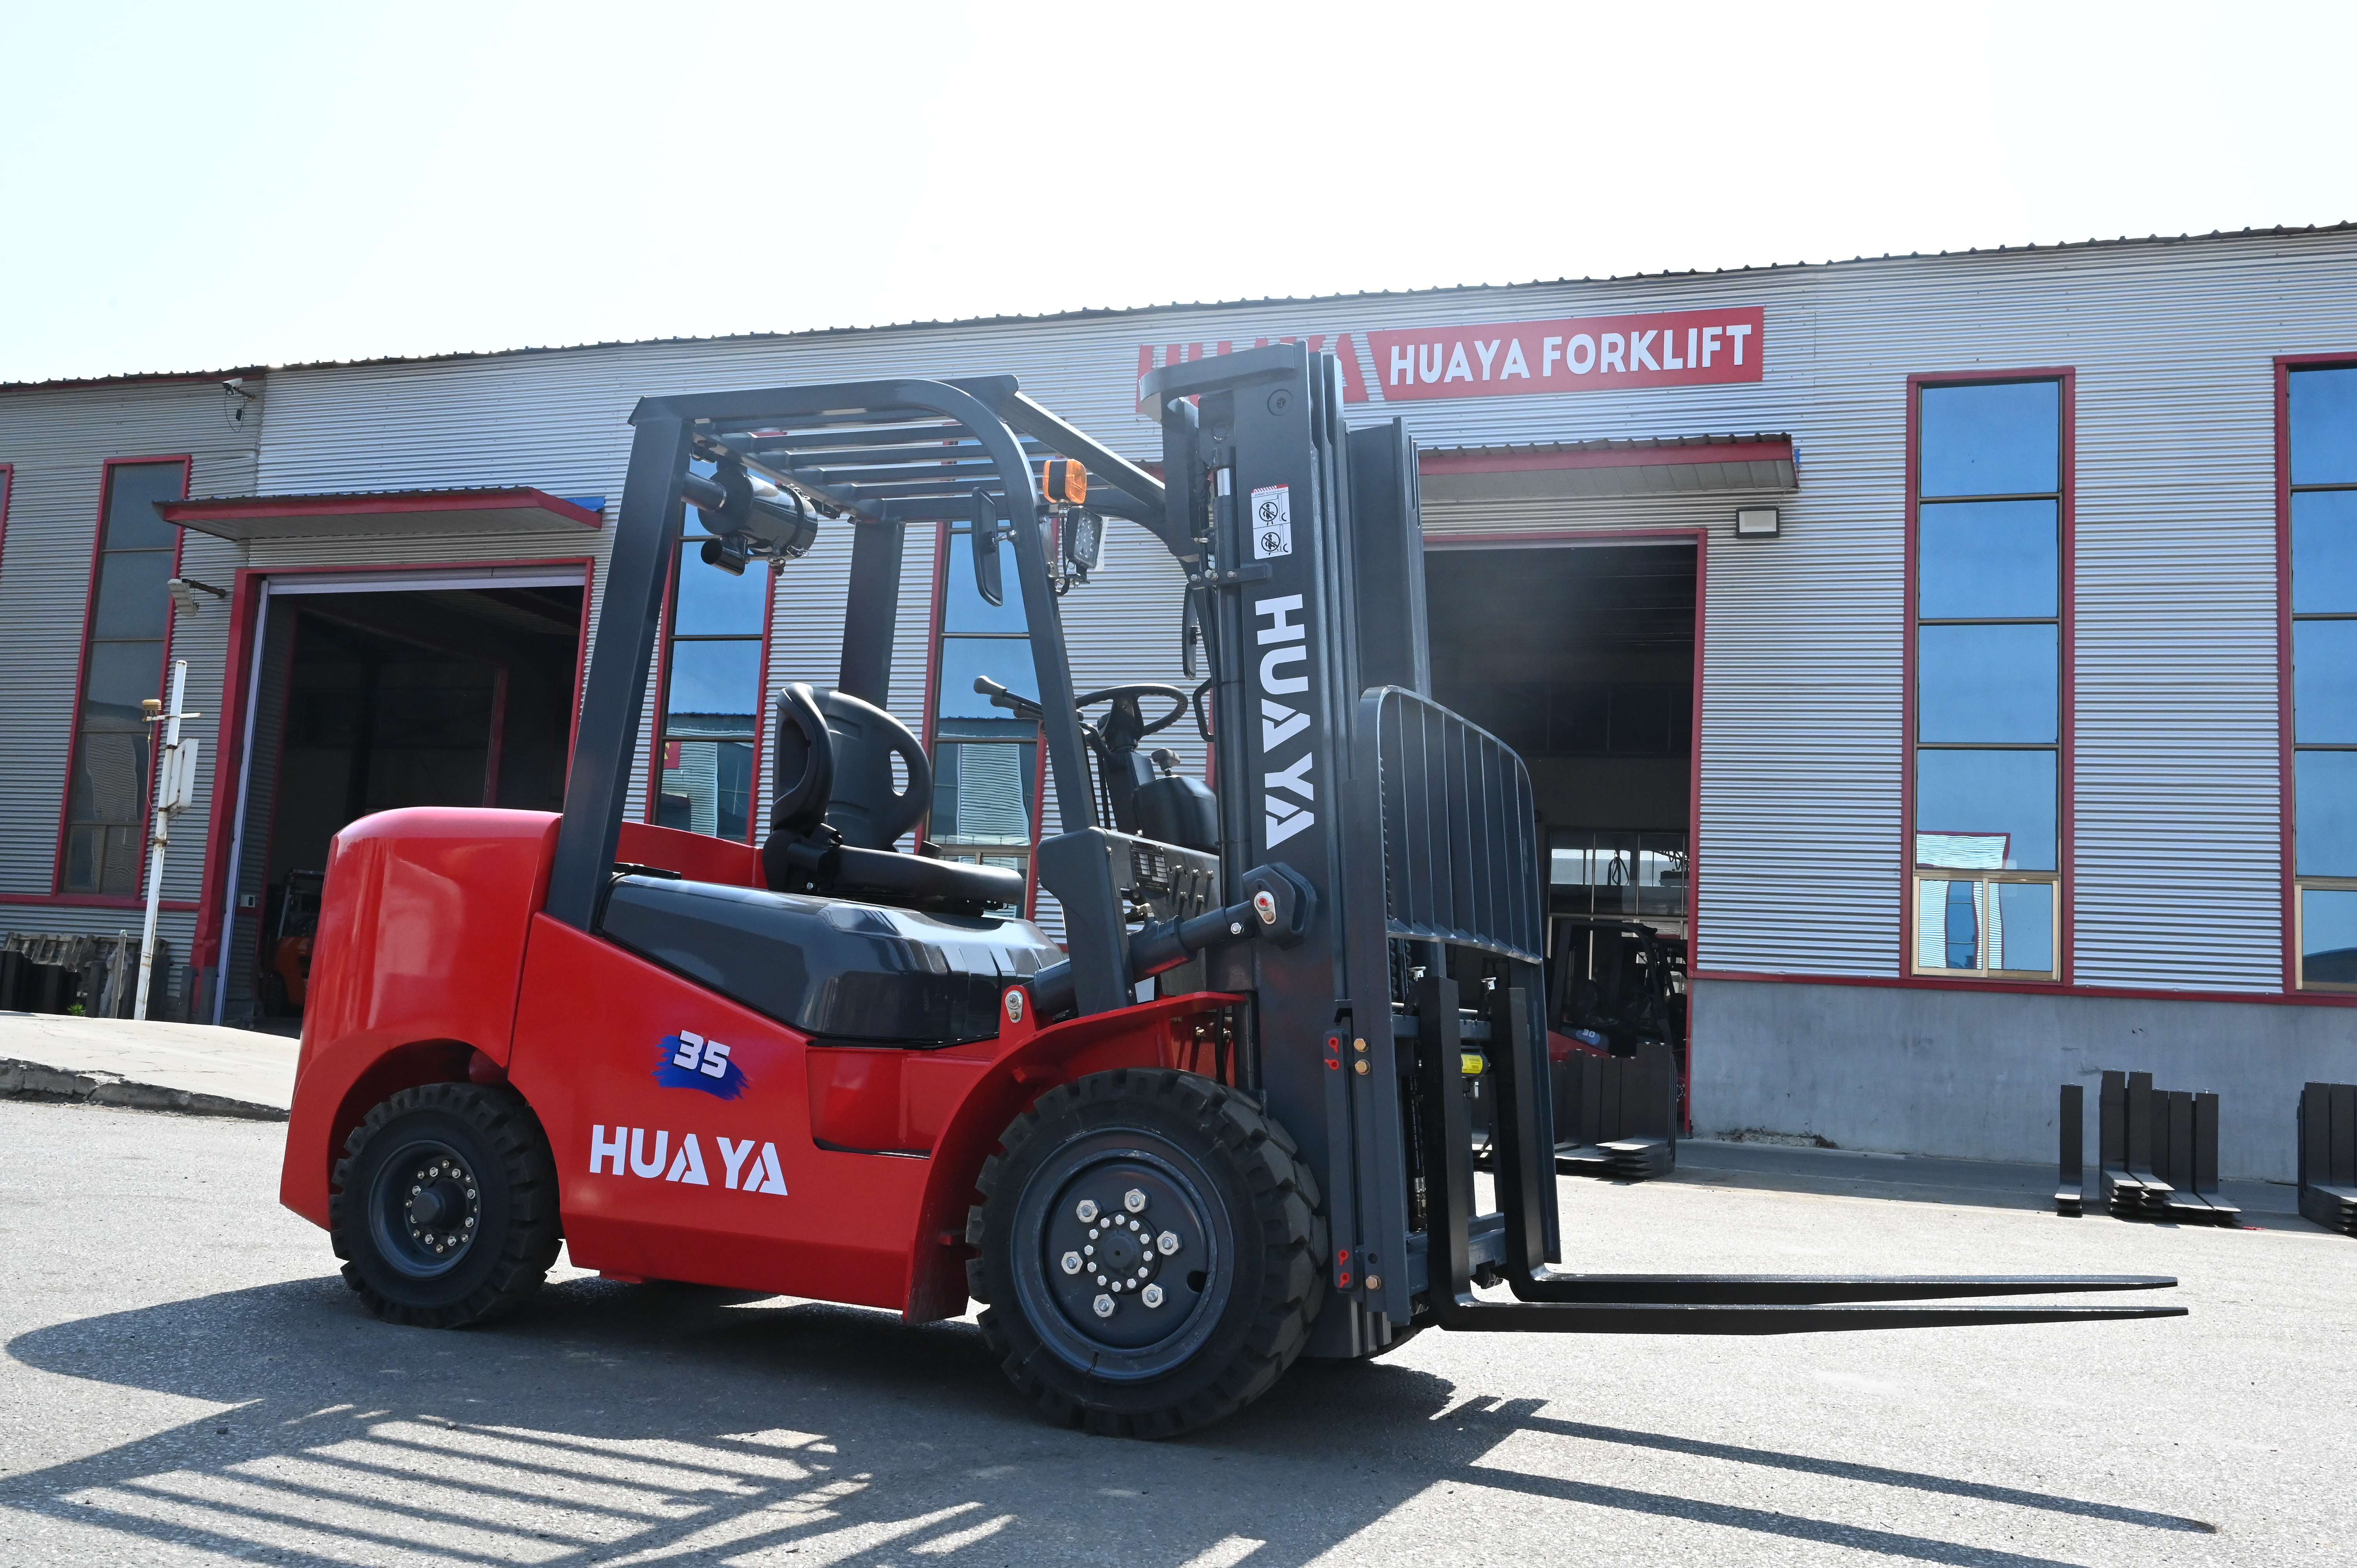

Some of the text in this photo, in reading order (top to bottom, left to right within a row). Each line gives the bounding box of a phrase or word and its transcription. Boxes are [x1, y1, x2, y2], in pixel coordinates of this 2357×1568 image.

[1390, 338, 1531, 385] HUAYA
[1542, 324, 1751, 377] FORKLIFT
[1255, 593, 1315, 850] HUAYA
[673, 1030, 731, 1078] 35
[1582, 1028, 1595, 1038] 30
[589, 1124, 788, 1196] HUAYA
